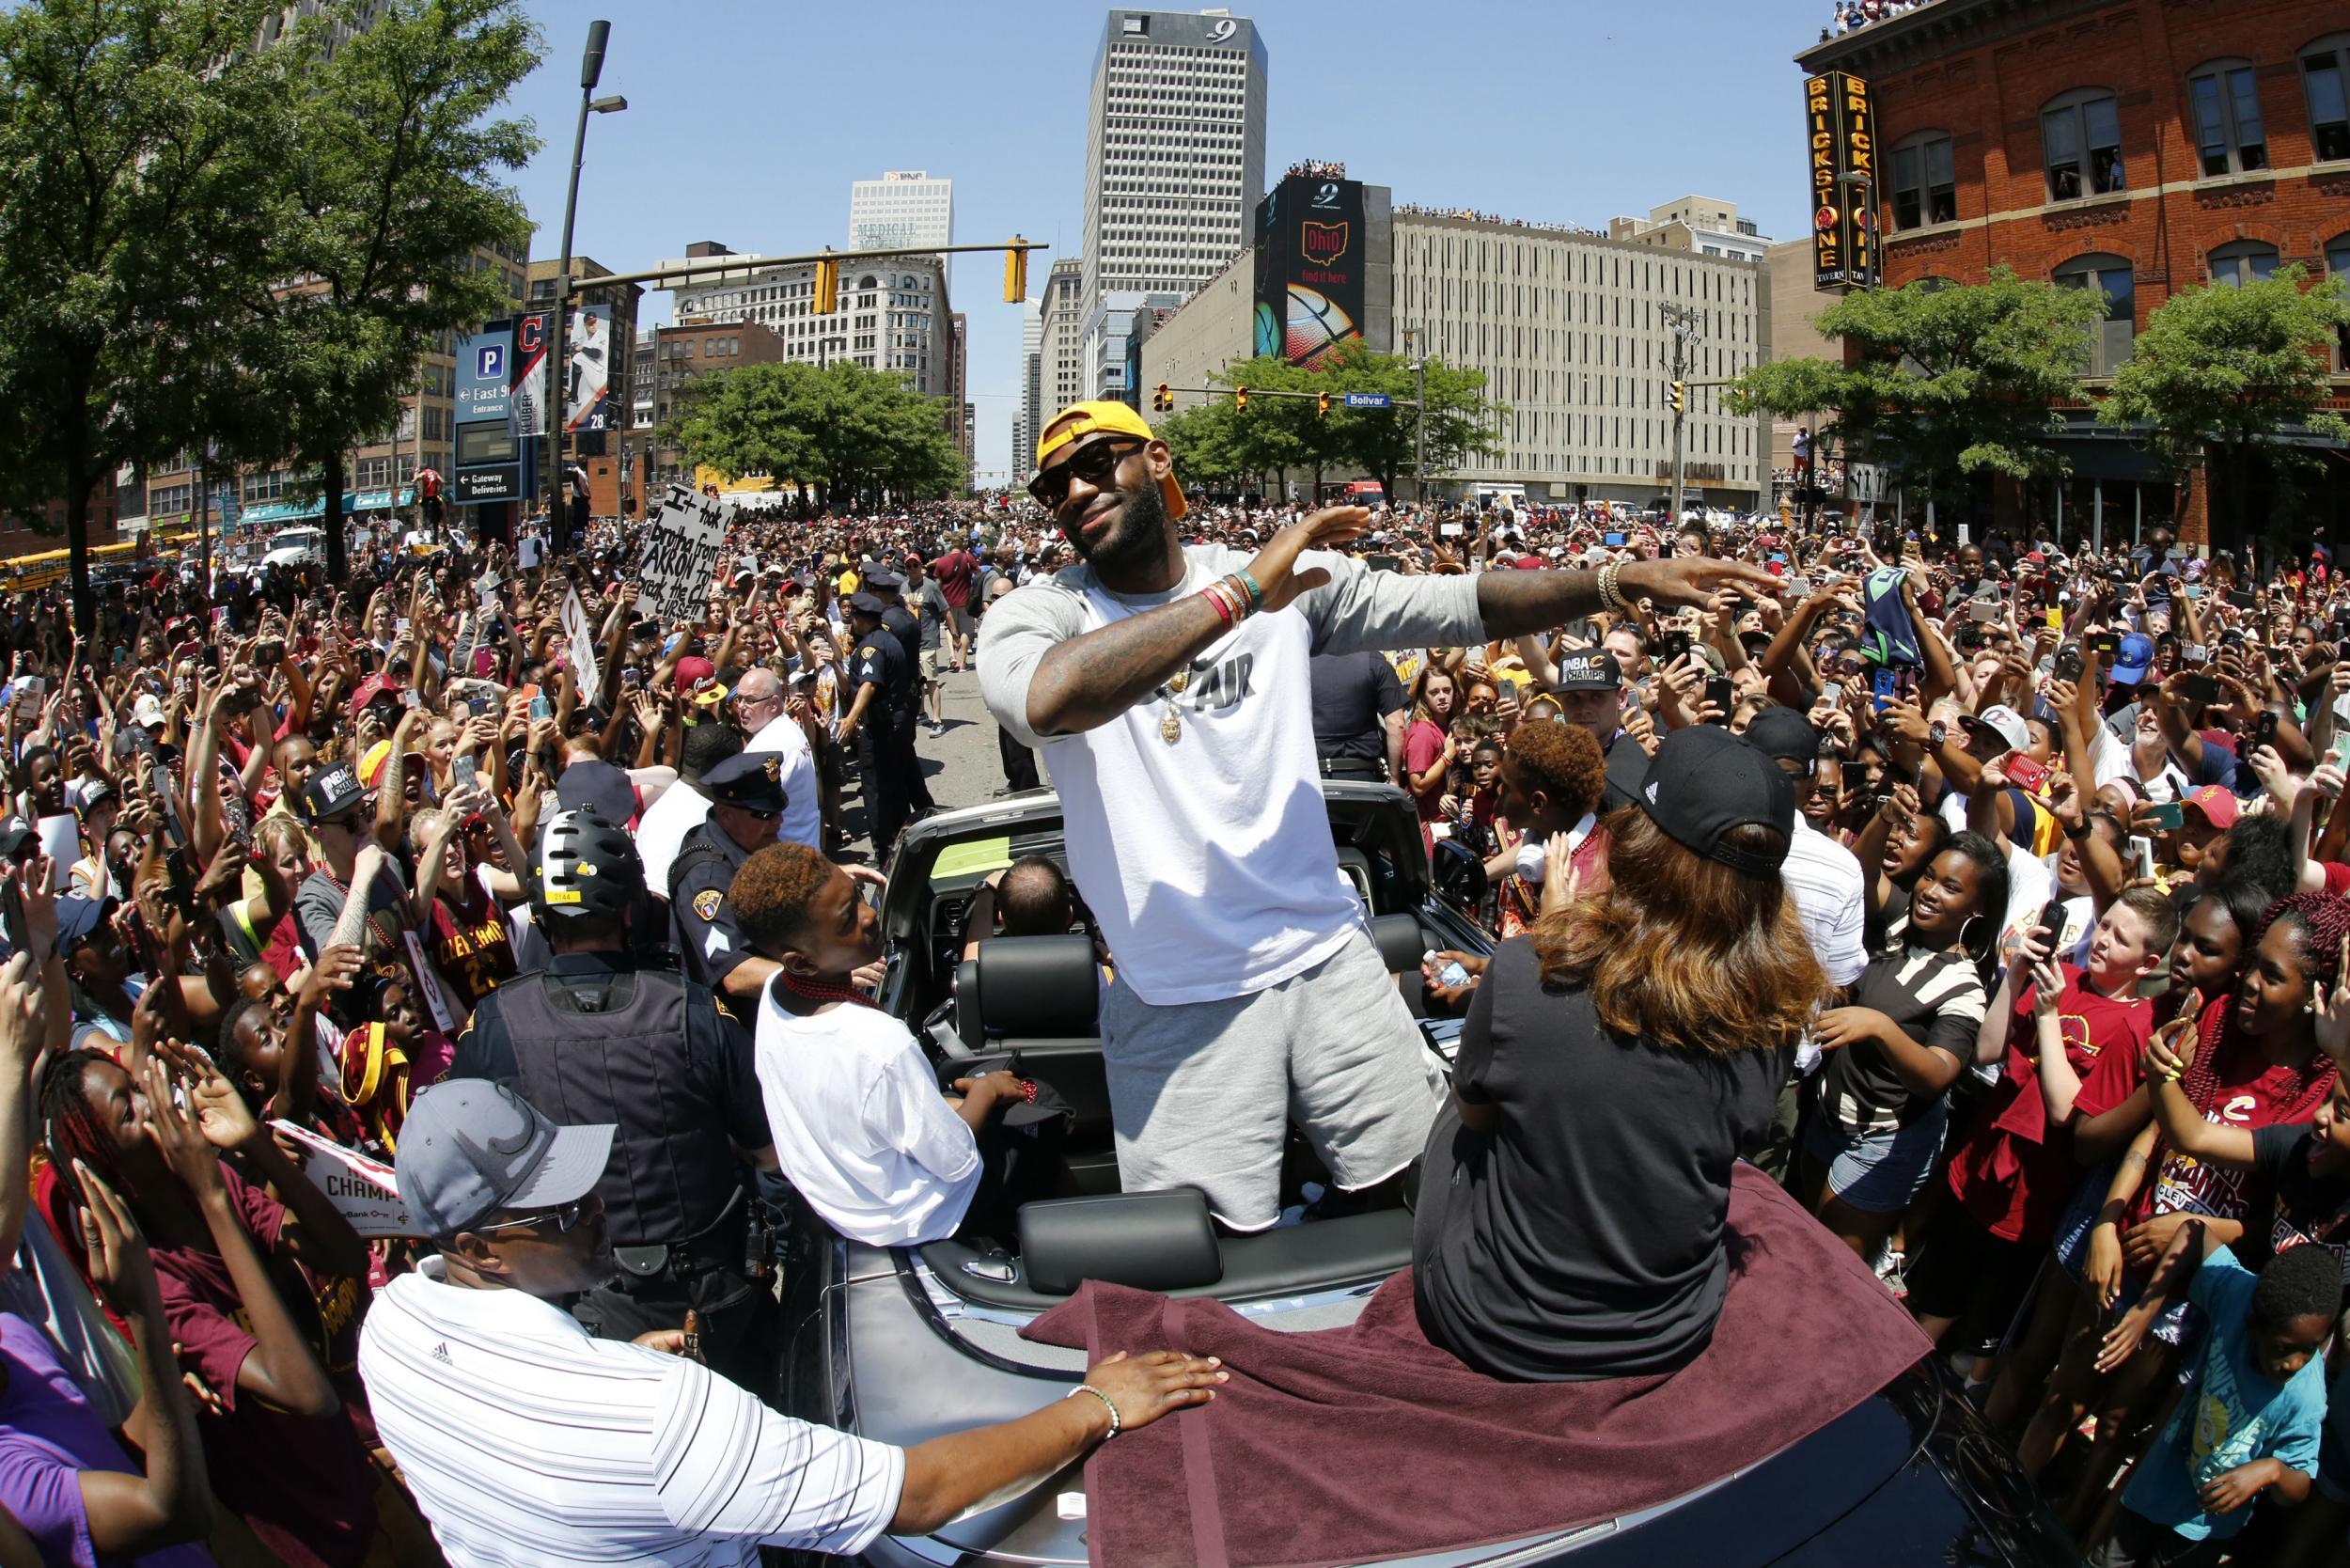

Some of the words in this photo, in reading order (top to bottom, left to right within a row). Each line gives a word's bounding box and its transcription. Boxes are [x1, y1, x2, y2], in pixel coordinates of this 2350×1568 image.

[1212, 20, 1237, 43] 9
[1809, 78, 1839, 268] BRICKSTONE
[1319, 183, 1339, 204] 9
[857, 223, 916, 236] MEDICAL
[1302, 270, 1317, 282] find
[1320, 272, 1326, 282] it
[1328, 273, 1347, 284] here
[1817, 270, 1845, 283] TAVERN
[1851, 270, 1881, 285] TAVN
[519, 315, 542, 353] C
[474, 387, 498, 401] East
[501, 384, 510, 398] 9
[1350, 396, 1385, 405] Bolivar
[473, 404, 504, 414] Entrance
[522, 394, 533, 434] KLUBER
[591, 414, 604, 430] 28
[472, 474, 503, 485] Gateway
[471, 484, 508, 495] Deliveries
[664, 485, 697, 514] It
[650, 511, 695, 555] brotha
[640, 542, 698, 580] AKRON
[697, 560, 712, 588] to
[670, 577, 689, 603] the
[1567, 657, 1590, 670] NBA
[1195, 652, 1257, 712] AIR
[1567, 670, 1606, 682] CHAMPS
[326, 768, 349, 788] NBA
